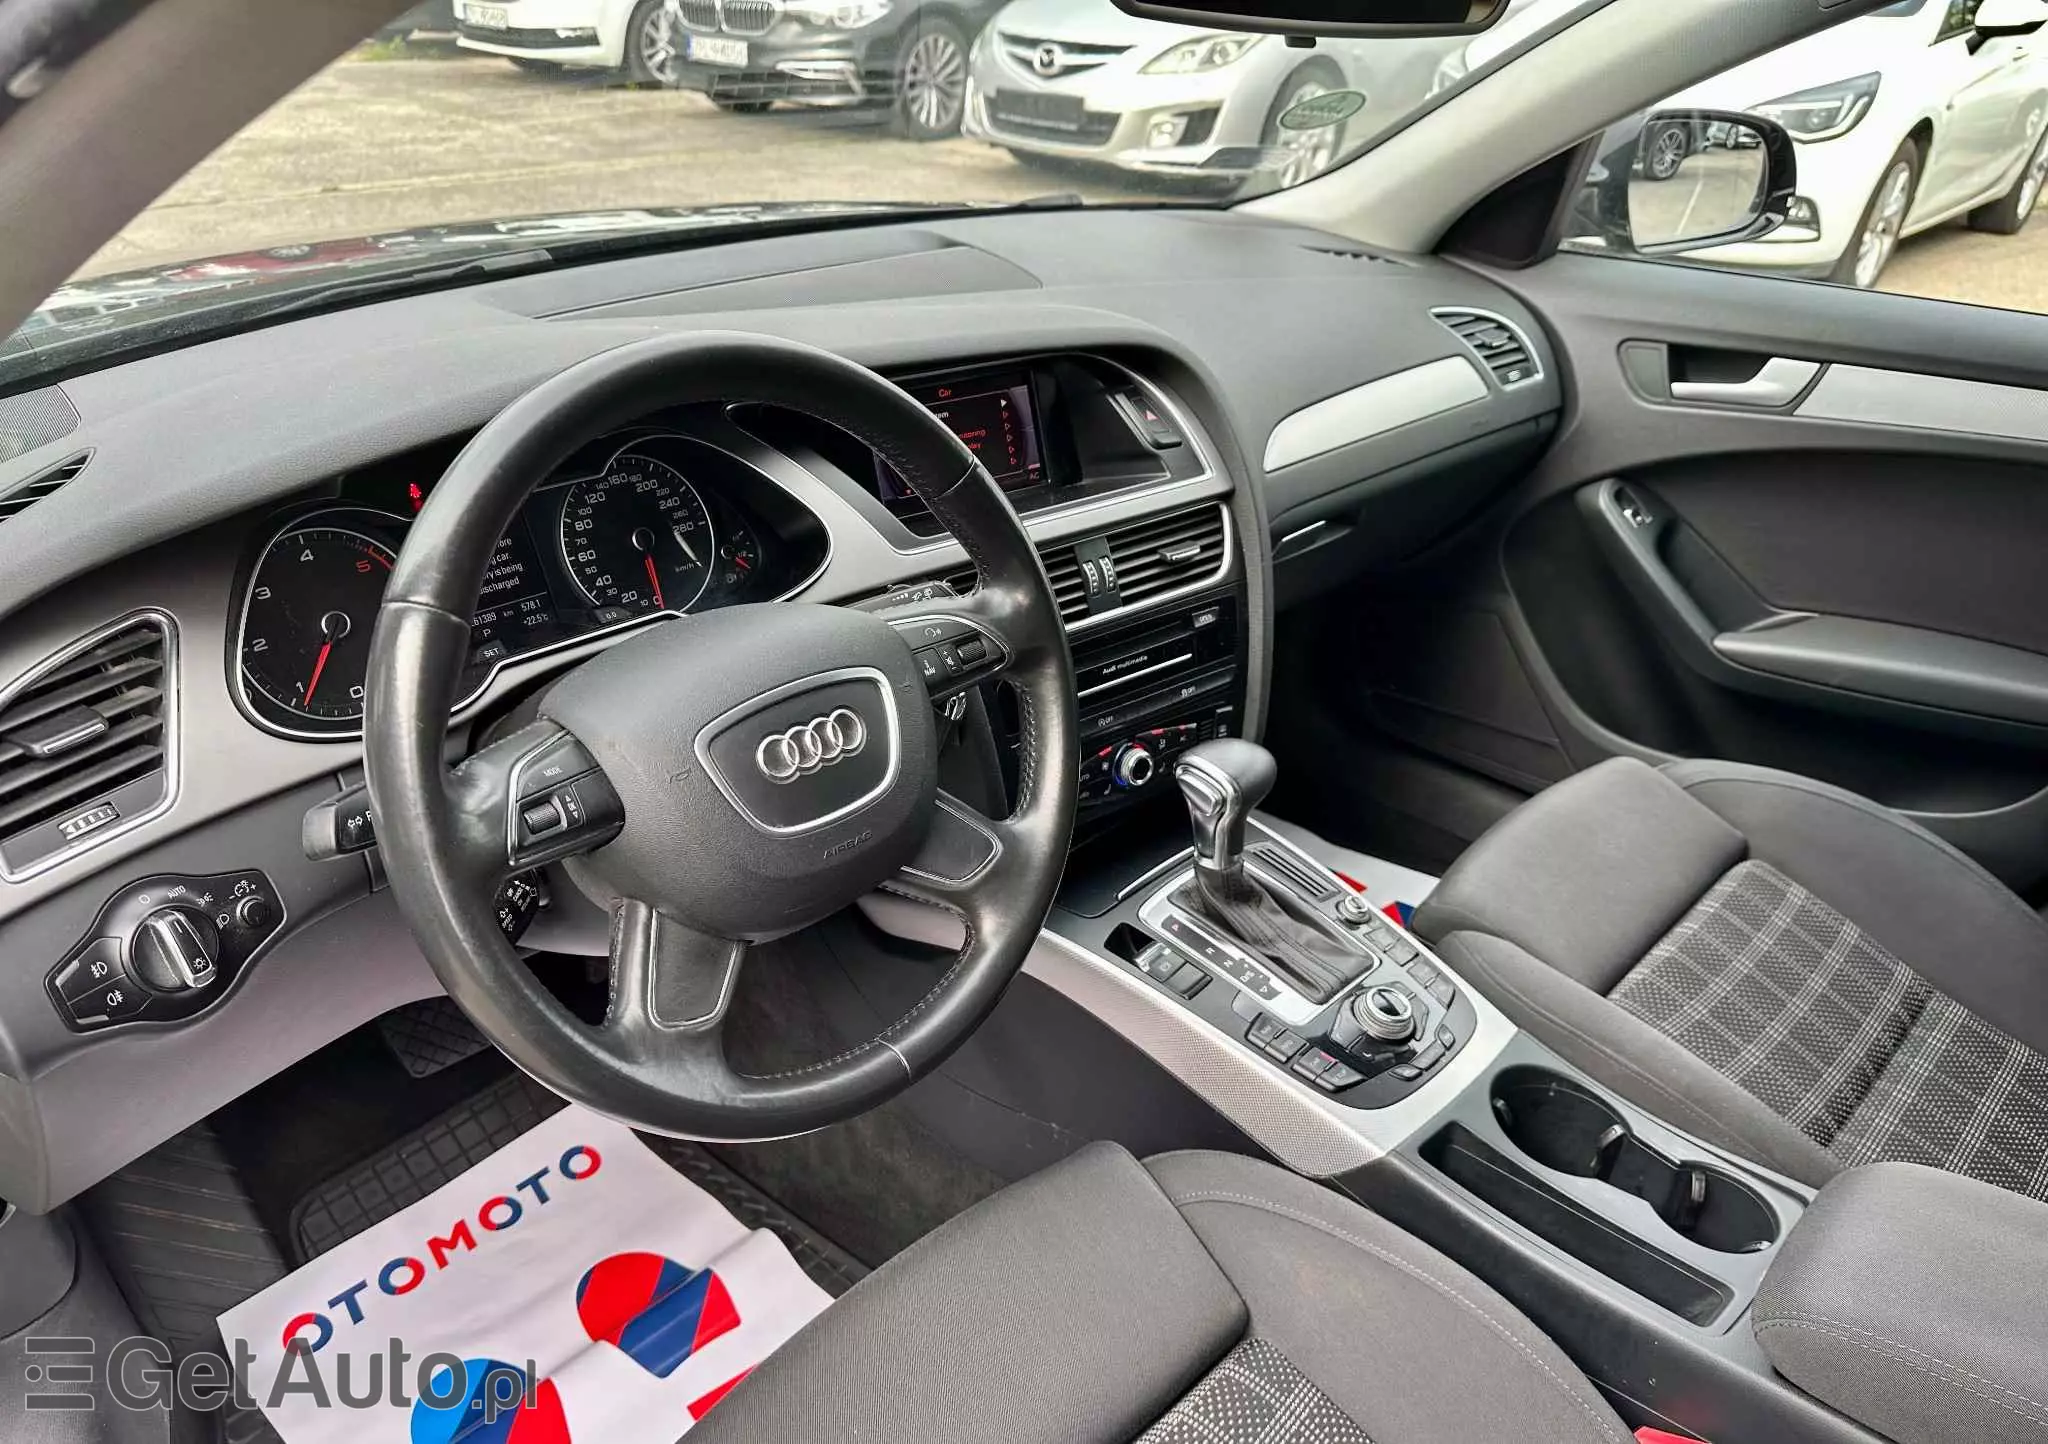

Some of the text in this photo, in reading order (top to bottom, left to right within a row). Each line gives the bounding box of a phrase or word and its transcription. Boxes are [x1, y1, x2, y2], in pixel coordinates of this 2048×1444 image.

[607, 472, 628, 485] 160
[595, 481, 609, 490] 140
[635, 479, 658, 493] 200
[656, 487, 670, 497] 220
[584, 491, 606, 504] 120
[659, 496, 681, 510] 240
[577, 506, 593, 516] 100
[672, 508, 689, 519] 260
[574, 518, 593, 531] 80
[672, 521, 695, 534] 280
[497, 537, 512, 548] ore
[574, 537, 588, 546] 70
[300, 549, 314, 562] 4
[577, 550, 597, 562] 60
[355, 560, 372, 573] 5
[501, 562, 524, 575] being
[585, 565, 598, 575] 50
[675, 563, 695, 573] km/h
[595, 574, 612, 587] 40
[255, 586, 272, 600] 3
[606, 587, 618, 596] 30
[621, 590, 638, 603] 20
[639, 599, 649, 607] 10
[471, 612, 497, 627] 61389
[482, 628, 491, 638] P
[252, 638, 269, 652] 2
[484, 647, 499, 658] SET
[1102, 665, 1117, 675] Audi
[295, 681, 305, 694] 1
[350, 685, 364, 699] 0
[167, 885, 186, 899] AUTO
[282, 1145, 603, 1357] OTOMOTO
